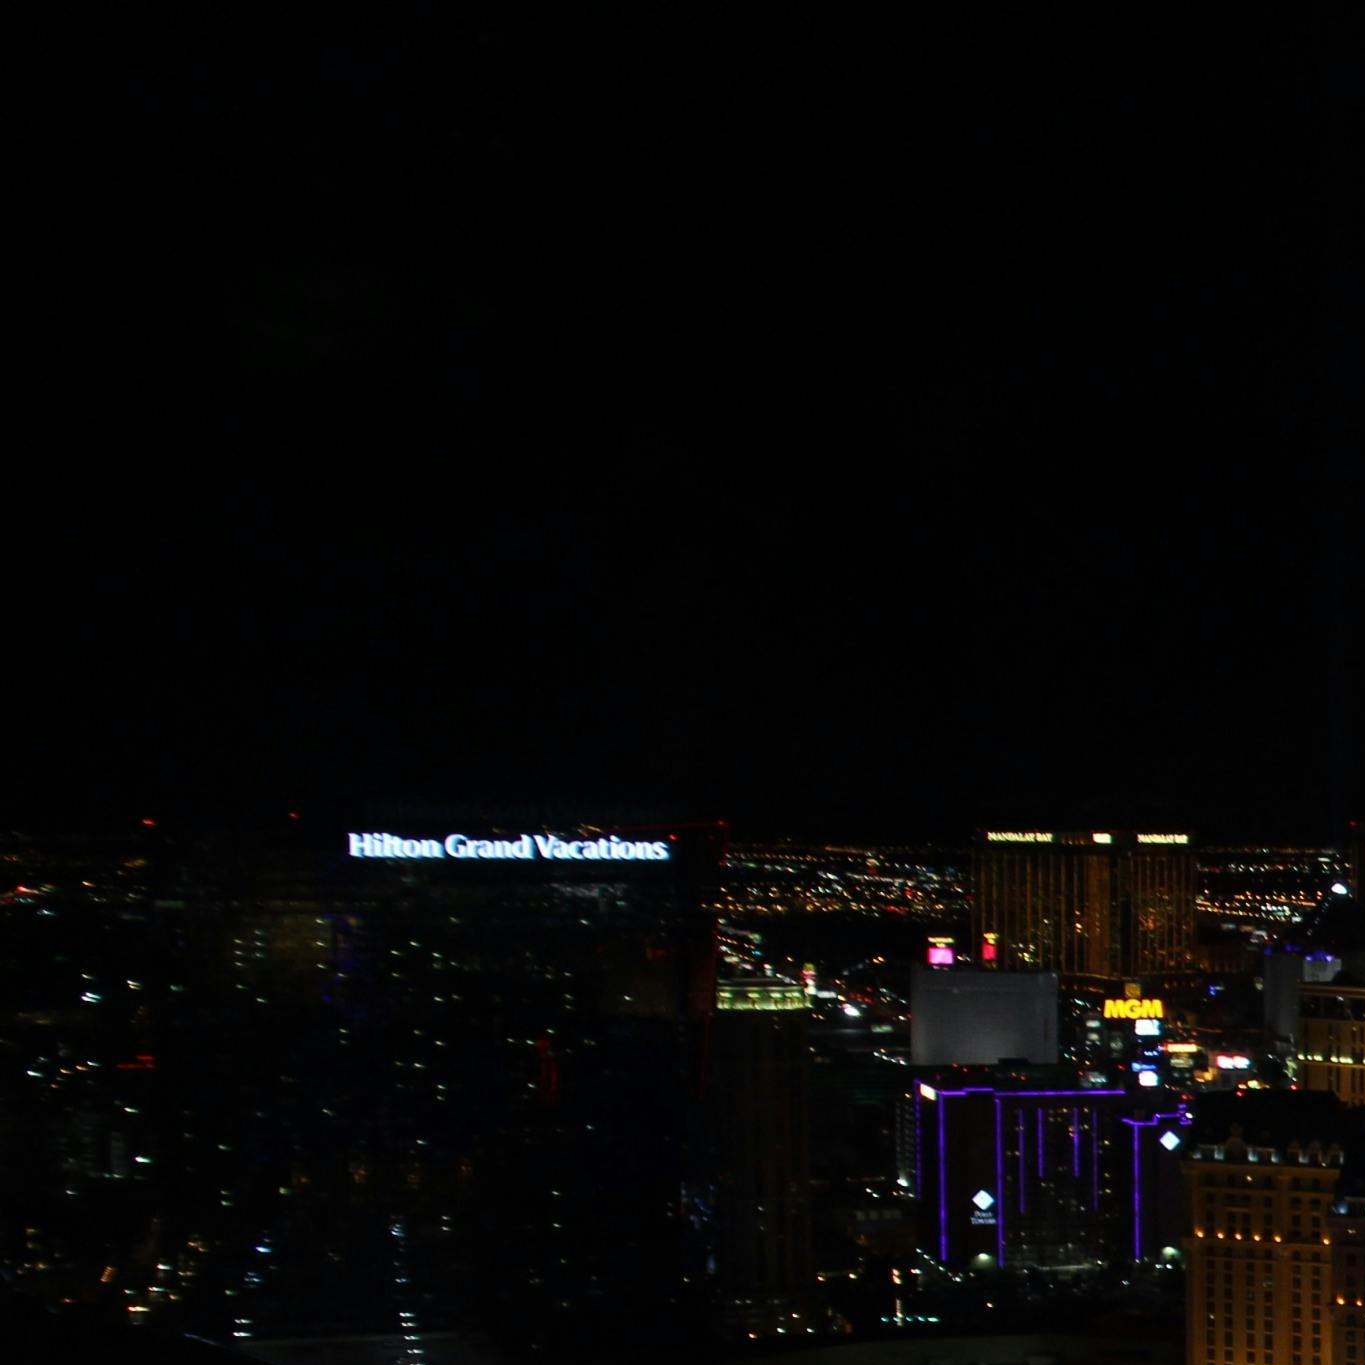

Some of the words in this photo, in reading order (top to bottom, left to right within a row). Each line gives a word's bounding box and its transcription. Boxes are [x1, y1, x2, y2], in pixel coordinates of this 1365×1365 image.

[349, 833, 444, 858] Hilton
[445, 834, 534, 860] Grand
[534, 835, 670, 861] Vacations
[1104, 999, 1164, 1020] MGM
